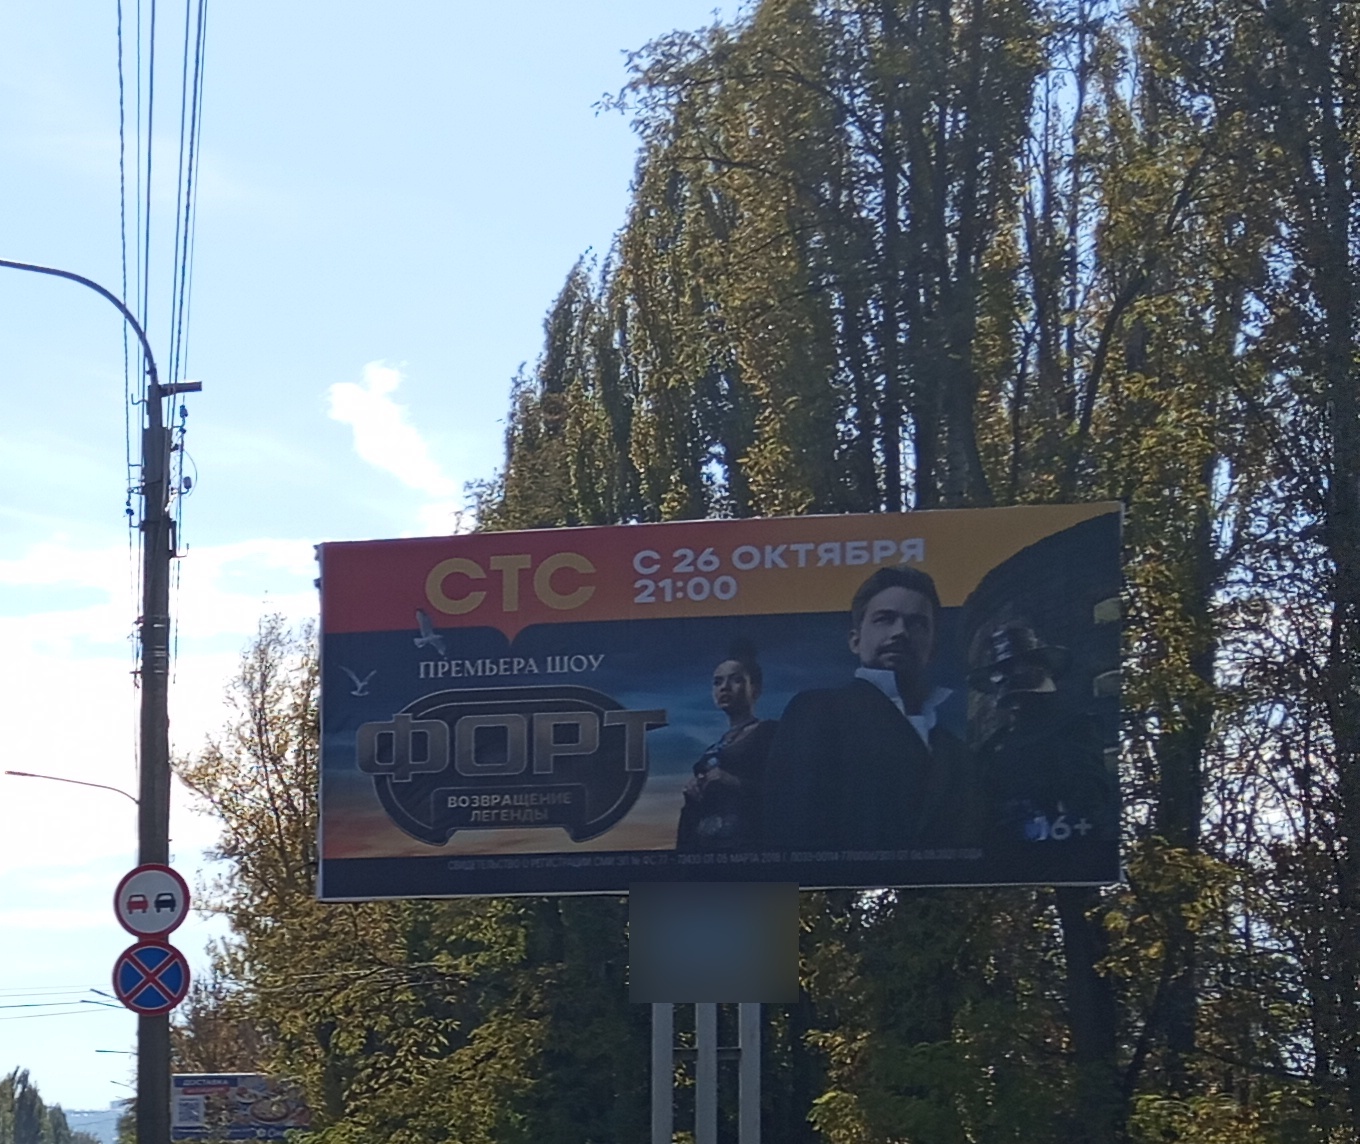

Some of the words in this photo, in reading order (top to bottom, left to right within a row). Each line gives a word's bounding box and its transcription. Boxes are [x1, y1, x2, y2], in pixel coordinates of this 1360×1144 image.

[632, 549, 661, 576] С
[672, 547, 721, 574] 26
[731, 537, 927, 571] ОКТЯБРЯ
[424, 552, 597, 615] СТС
[632, 575, 738, 603] 21:00
[419, 657, 539, 679] ПРЕМЬЕРА
[546, 654, 606, 673] ШОУ
[355, 708, 670, 783] ФОРТ
[446, 791, 573, 808] ВОЗВРАЩЕНИЕ
[469, 809, 549, 824] ЛЕГЕНДЫ
[1031, 814, 1094, 840] 16+
